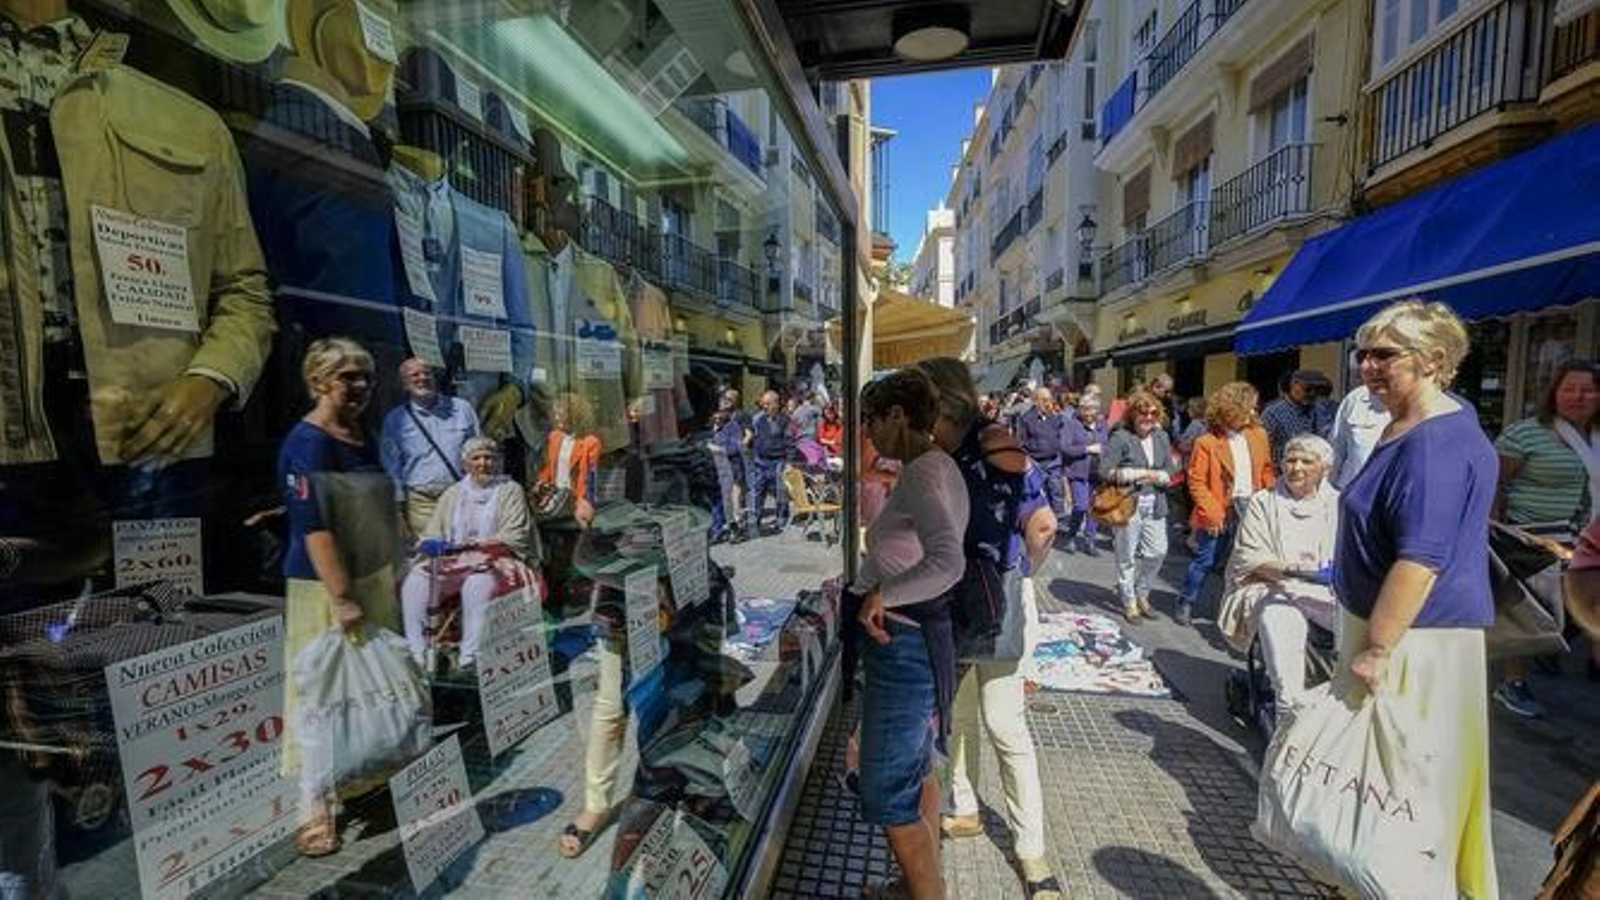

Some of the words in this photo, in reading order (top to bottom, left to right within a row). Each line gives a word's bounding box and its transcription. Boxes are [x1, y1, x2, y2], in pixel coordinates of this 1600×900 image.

[117, 653, 186, 684] Nueva
[190, 622, 278, 662] Colección
[142, 647, 268, 709] CAMISAS
